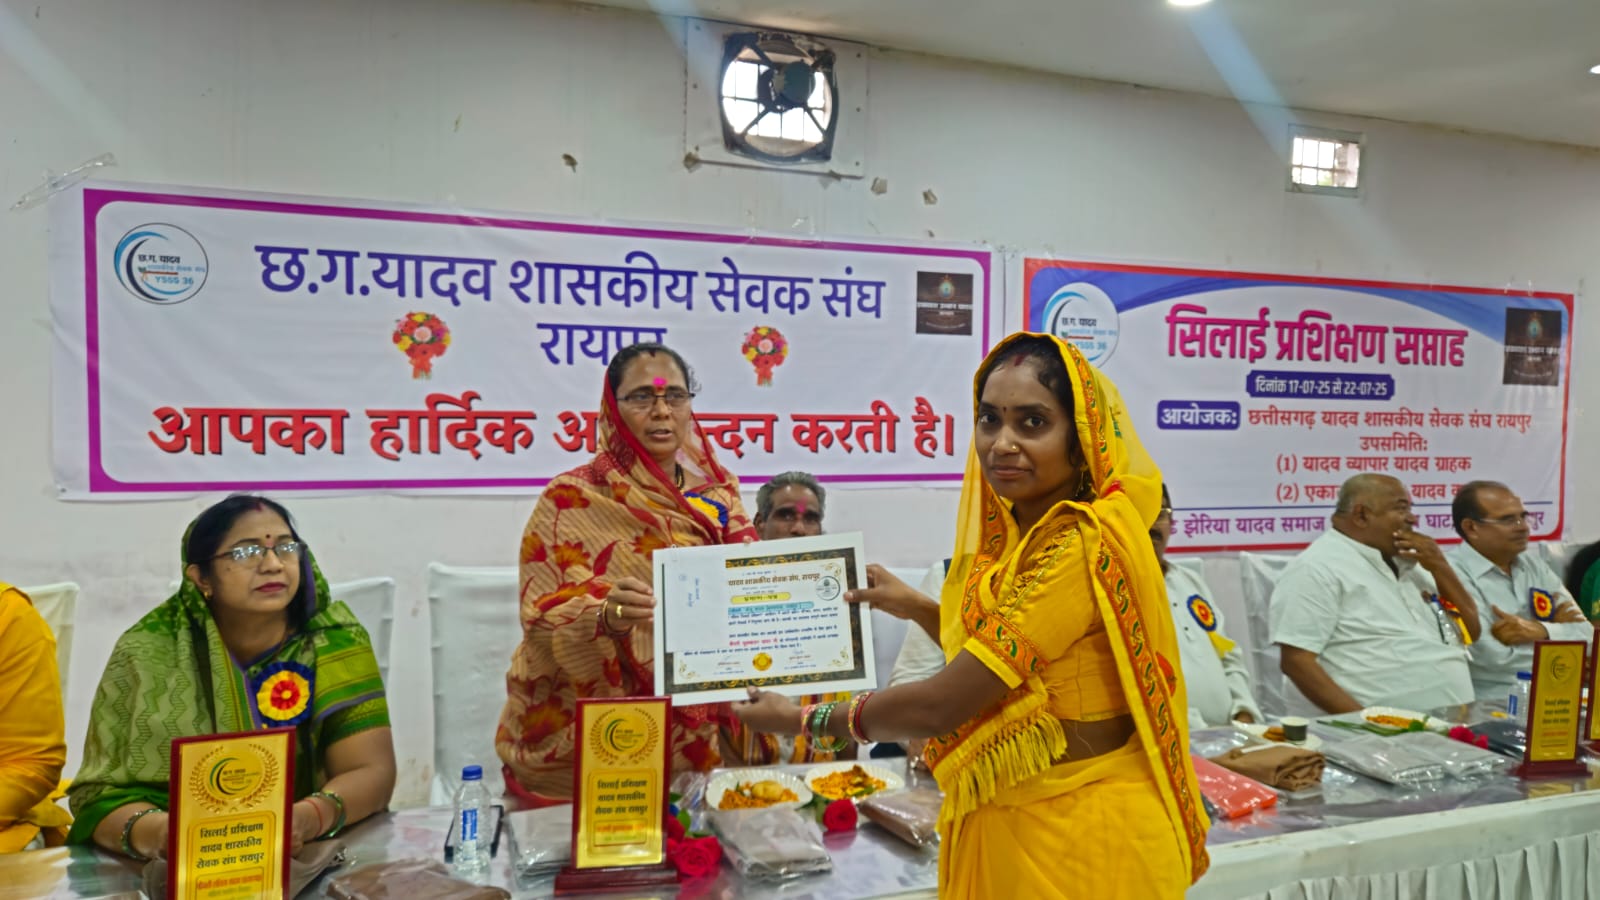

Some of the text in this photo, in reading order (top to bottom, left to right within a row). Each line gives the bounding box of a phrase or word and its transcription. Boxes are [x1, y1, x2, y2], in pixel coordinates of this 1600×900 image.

[254, 245, 885, 319] छ.ग.यादव शासकीय सेवक संघ
[536, 322, 668, 366] रायप
[1165, 304, 1468, 367] सिलाई प्रशिक्षण सप्ताह
[1255, 375, 1387, 396] दिनांक 17-07-25 से 22-07-25
[147, 405, 350, 456] आपका
[365, 391, 537, 461] हार्दिक
[792, 400, 900, 454] करती
[912, 396, 954, 457] है।
[1161, 403, 1532, 434] आयोजक: छत्तीसगढ़ यादव शासकीय सेवक संघ रायपुर
[1359, 431, 1428, 452] उपसमिति:
[1277, 453, 1472, 474] (1) यादव व्यापार यादव ग्राहक
[1276, 482, 1299, 503] (2)
[1304, 484, 1342, 503] एका
[1411, 484, 1446, 501] यादव
[1183, 513, 1230, 538] झेरिया
[1236, 517, 1275, 535] यादव
[1281, 516, 1325, 533] समाज
[200, 824, 228, 839] सिलाई
